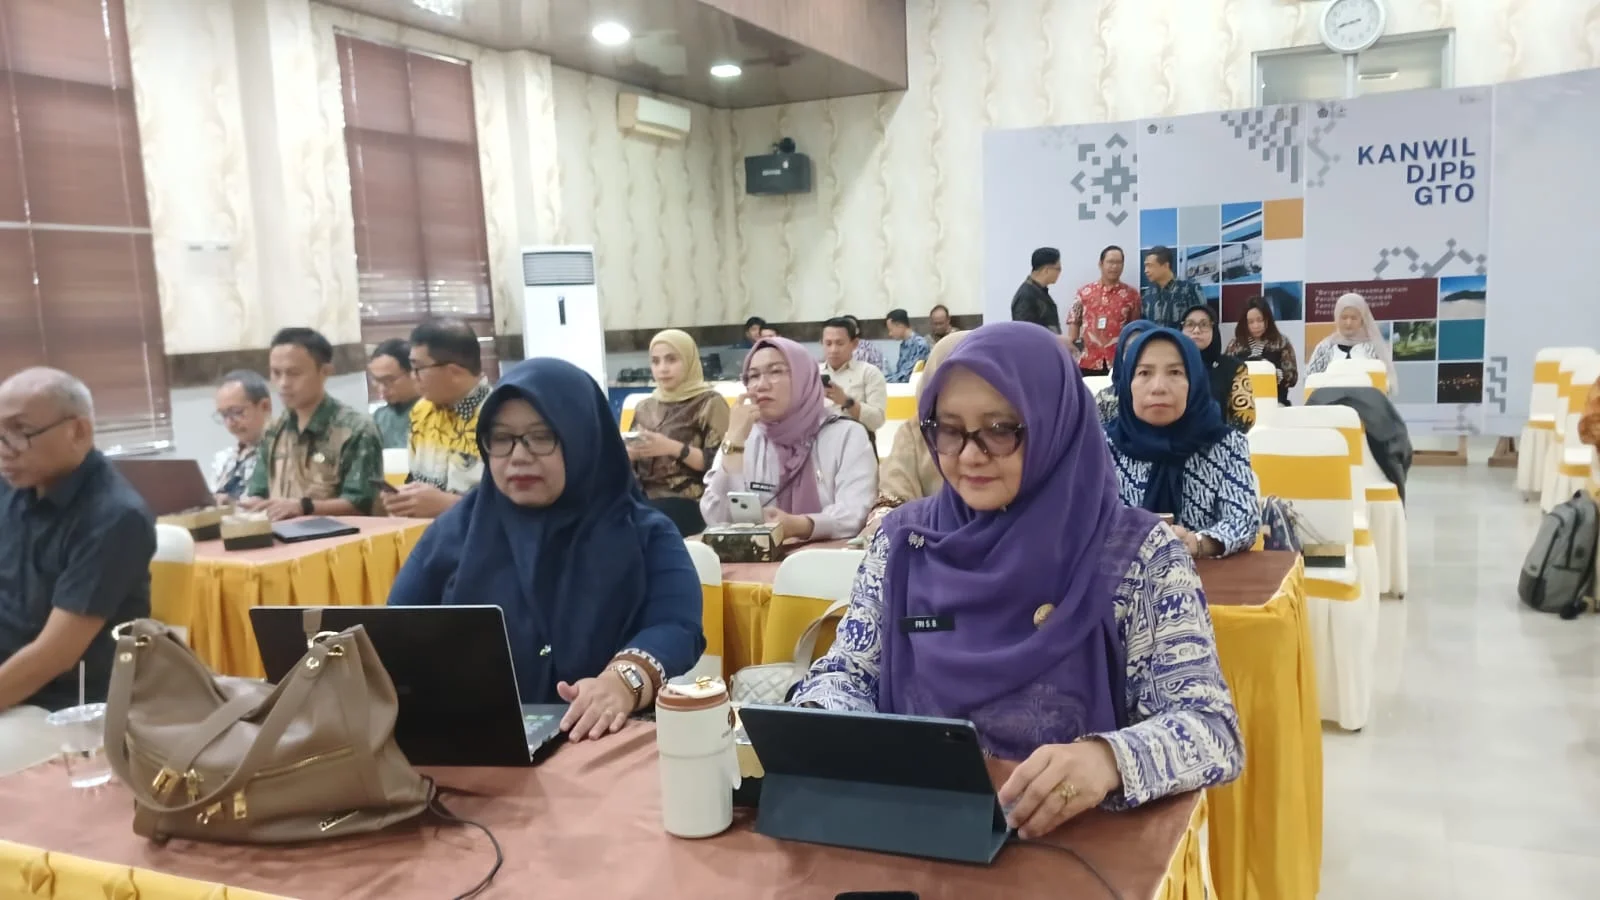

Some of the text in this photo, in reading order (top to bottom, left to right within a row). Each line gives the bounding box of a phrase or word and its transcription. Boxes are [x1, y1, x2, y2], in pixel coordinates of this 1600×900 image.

[1358, 137, 1476, 165] KANWIL
[1407, 160, 1475, 184] DJPb
[1415, 183, 1474, 206] GTO
